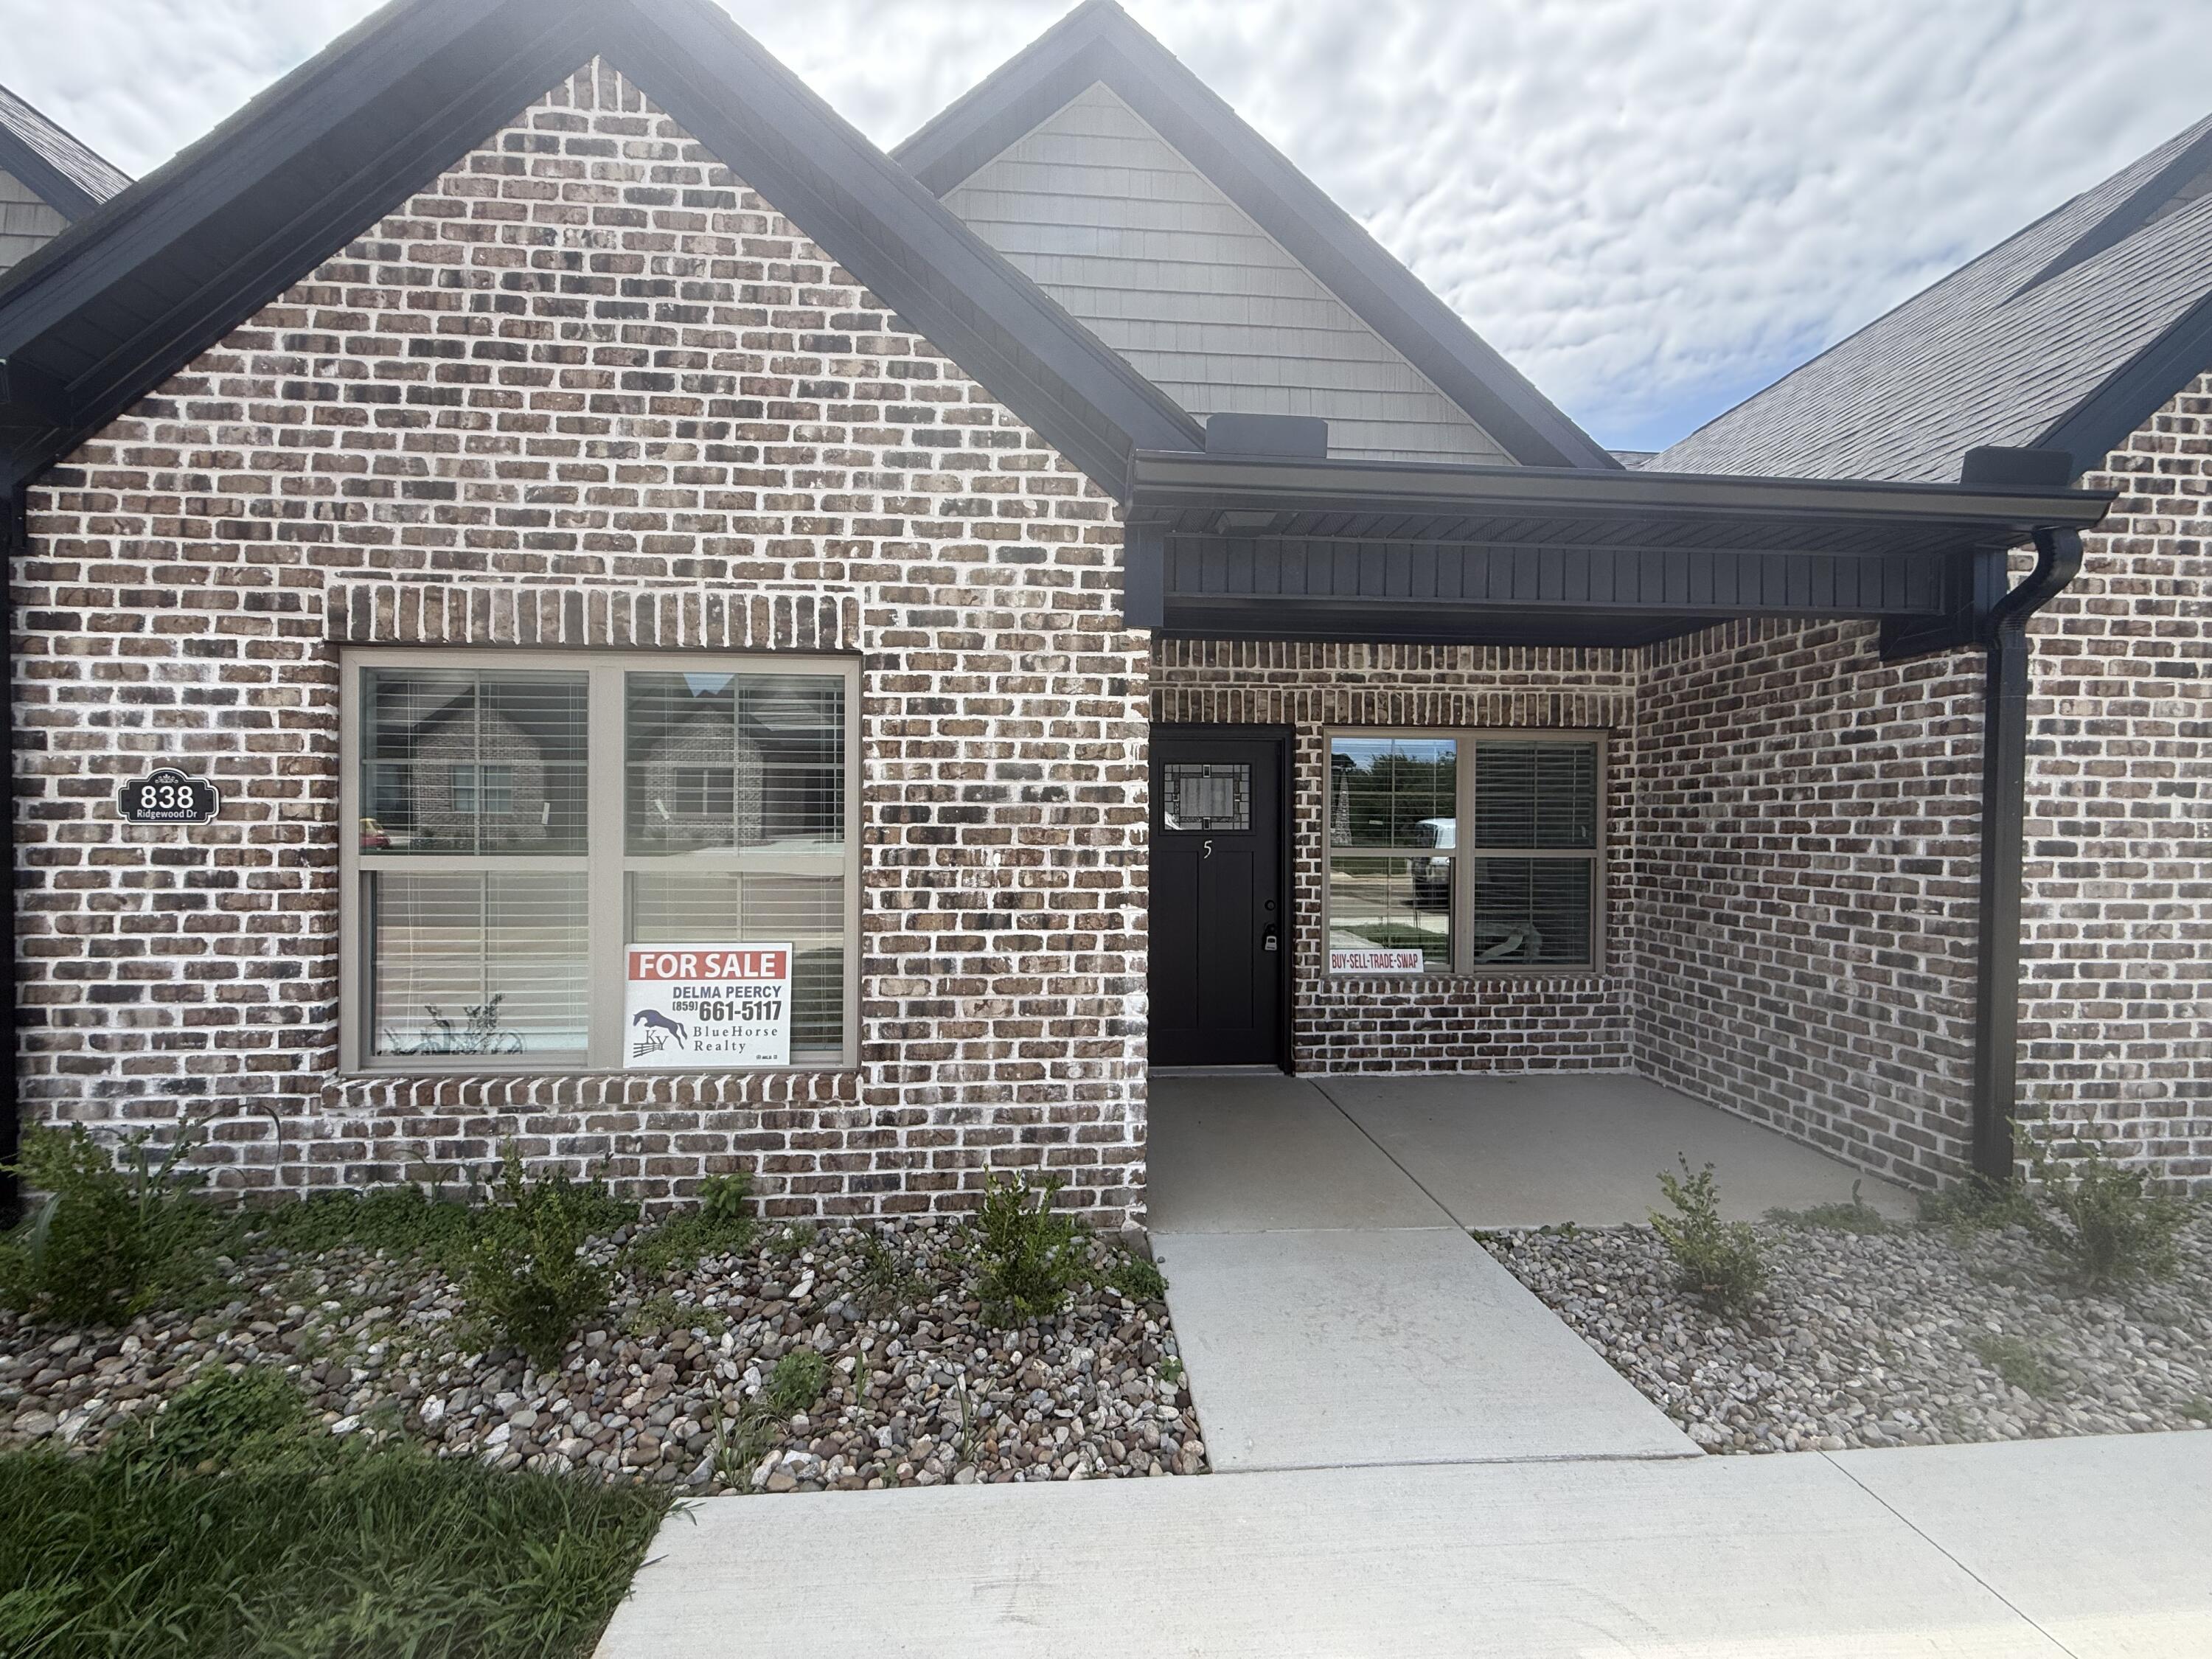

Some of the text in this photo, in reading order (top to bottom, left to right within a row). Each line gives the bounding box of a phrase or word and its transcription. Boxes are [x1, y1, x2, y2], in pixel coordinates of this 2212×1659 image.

[141, 785, 193, 808] 838
[136, 809, 198, 819] Ridgewood Dr
[1203, 840, 1212, 859] 5
[639, 953, 776, 978] FOR SALE
[1332, 953, 1418, 969] BUY-SELL-TRADE-SWAP
[672, 986, 782, 998] DELMA PEERCY
[672, 1001, 782, 1021] (859) 661-5117
[645, 1029, 669, 1051] KY
[693, 1026, 778, 1037] BlueHorse
[694, 1040, 745, 1054] Realty
